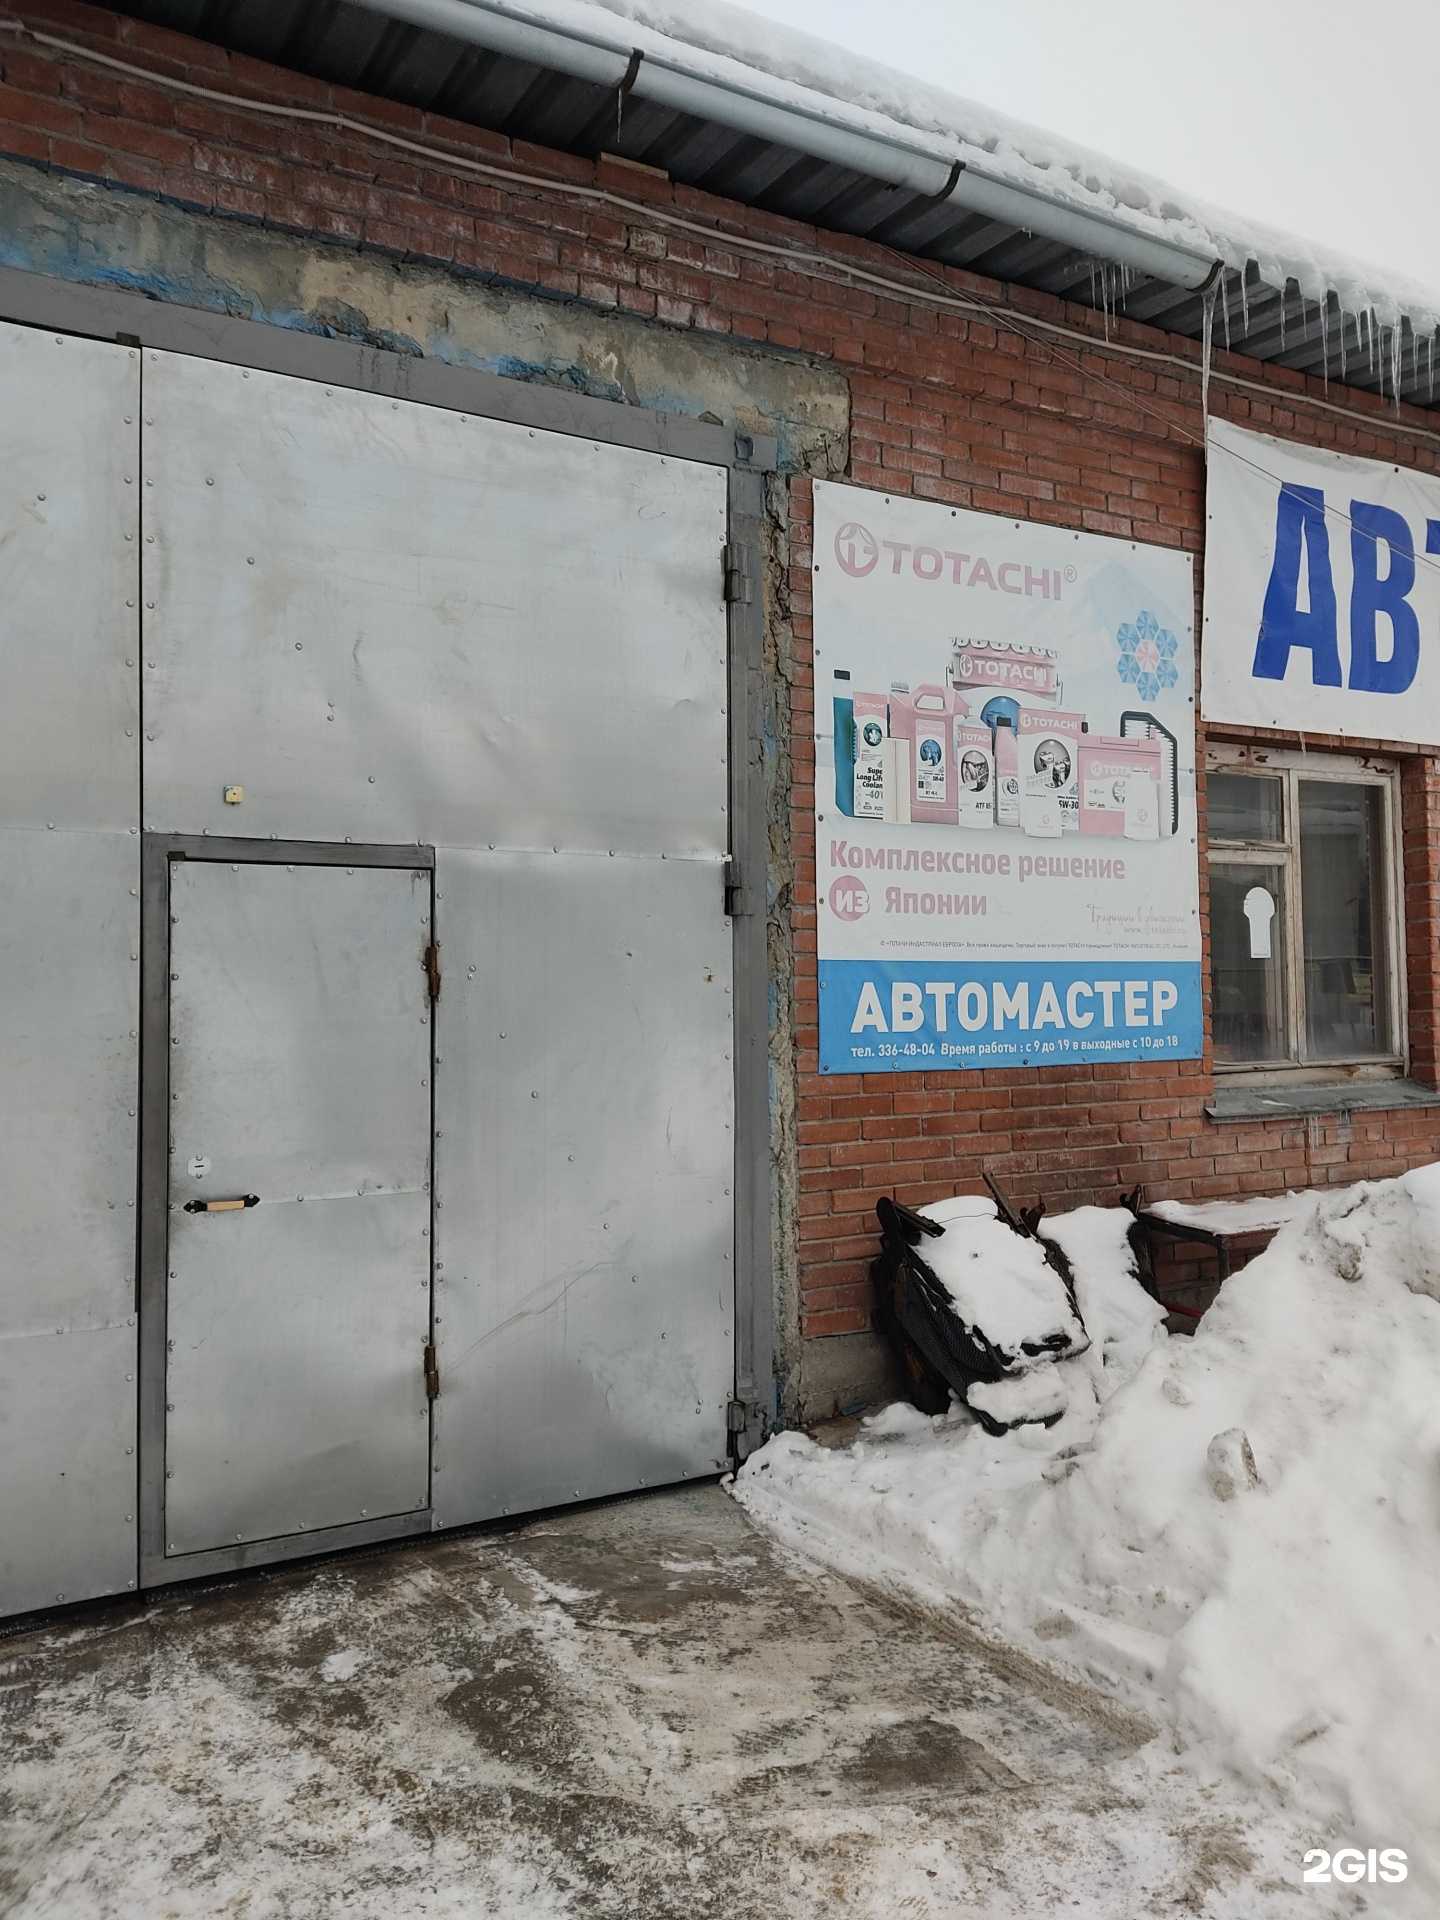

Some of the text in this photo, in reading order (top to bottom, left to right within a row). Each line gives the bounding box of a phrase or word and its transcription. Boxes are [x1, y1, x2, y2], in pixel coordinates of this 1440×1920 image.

[1252, 481, 1440, 694] АВ
[974, 660, 1047, 681] TOTACHI
[1032, 717, 1078, 730] TOTACHI
[856, 772, 872, 783] Long
[862, 781, 883, 789] Coolan
[1058, 799, 1079, 810] 5W-30
[829, 839, 1126, 882] Комплексное решение
[835, 885, 988, 916] ИЗ Японии
[850, 980, 1178, 1033] АВТОМАСТЕР
[851, 1046, 875, 1057] тел.
[878, 1043, 936, 1057] 336-48-04
[941, 1042, 976, 1057] Время
[978, 1041, 1017, 1056] работы
[1025, 1043, 1032, 1053] с
[1033, 1040, 1041, 1052] 9
[1041, 1041, 1055, 1054] до
[1057, 1039, 1070, 1051] 19
[1072, 1040, 1079, 1050] в
[1081, 1037, 1130, 1051] выходные
[1132, 1039, 1138, 1049] с
[1140, 1036, 1152, 1048] 10
[1152, 1037, 1165, 1048] до
[1166, 1034, 1179, 1047] 18
